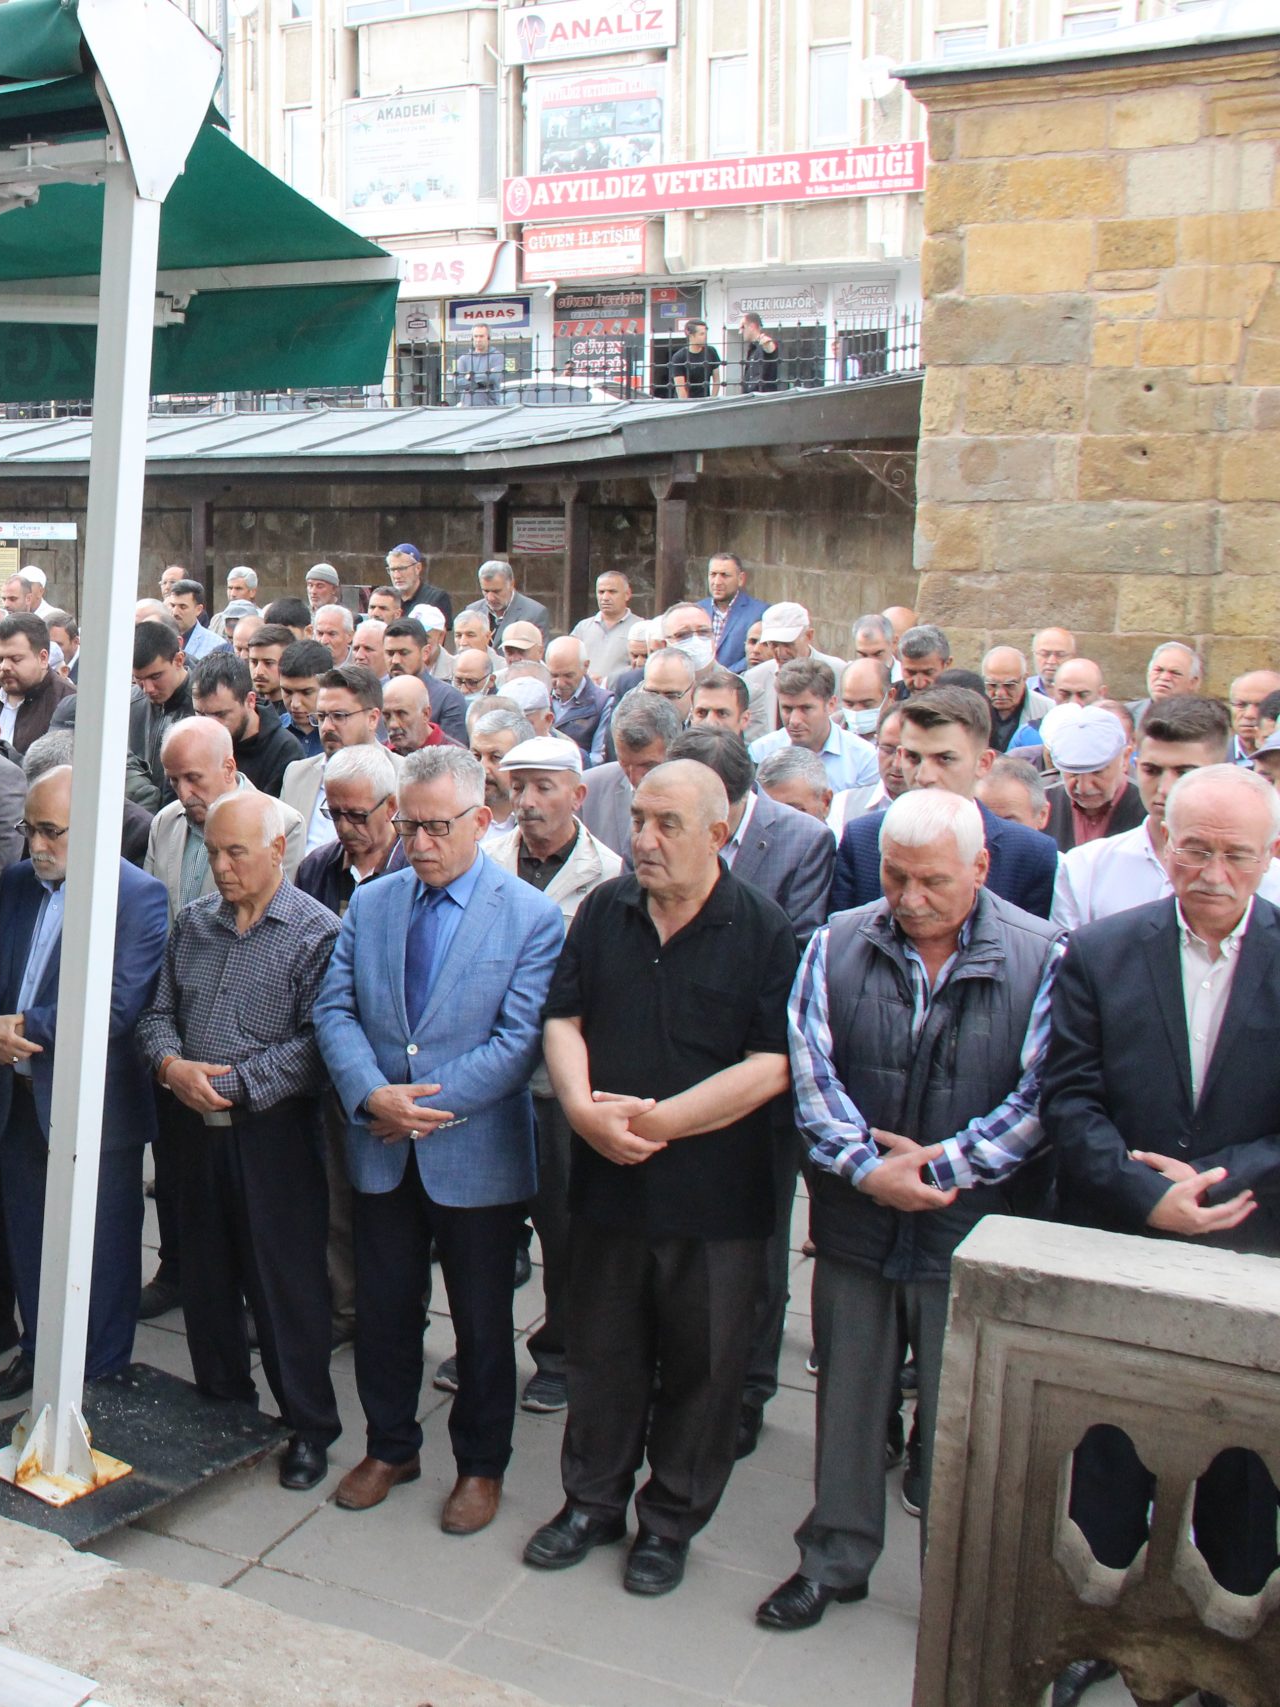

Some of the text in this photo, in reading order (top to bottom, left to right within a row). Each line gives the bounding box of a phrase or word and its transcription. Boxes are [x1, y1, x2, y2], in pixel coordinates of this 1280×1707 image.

[377, 99, 436, 121] AKADEMİ
[532, 174, 646, 206] AYYILDIZ
[652, 159, 801, 195] VETERİNER
[808, 143, 914, 183] KLİNİĞİ
[528, 232, 575, 250] GÜVEN
[405, 259, 465, 285] BAŞ
[859, 286, 888, 295] KUTAY
[463, 308, 516, 319] HABAŞ
[741, 298, 770, 311] ERKEK
[573, 338, 625, 356] GÜVEN
